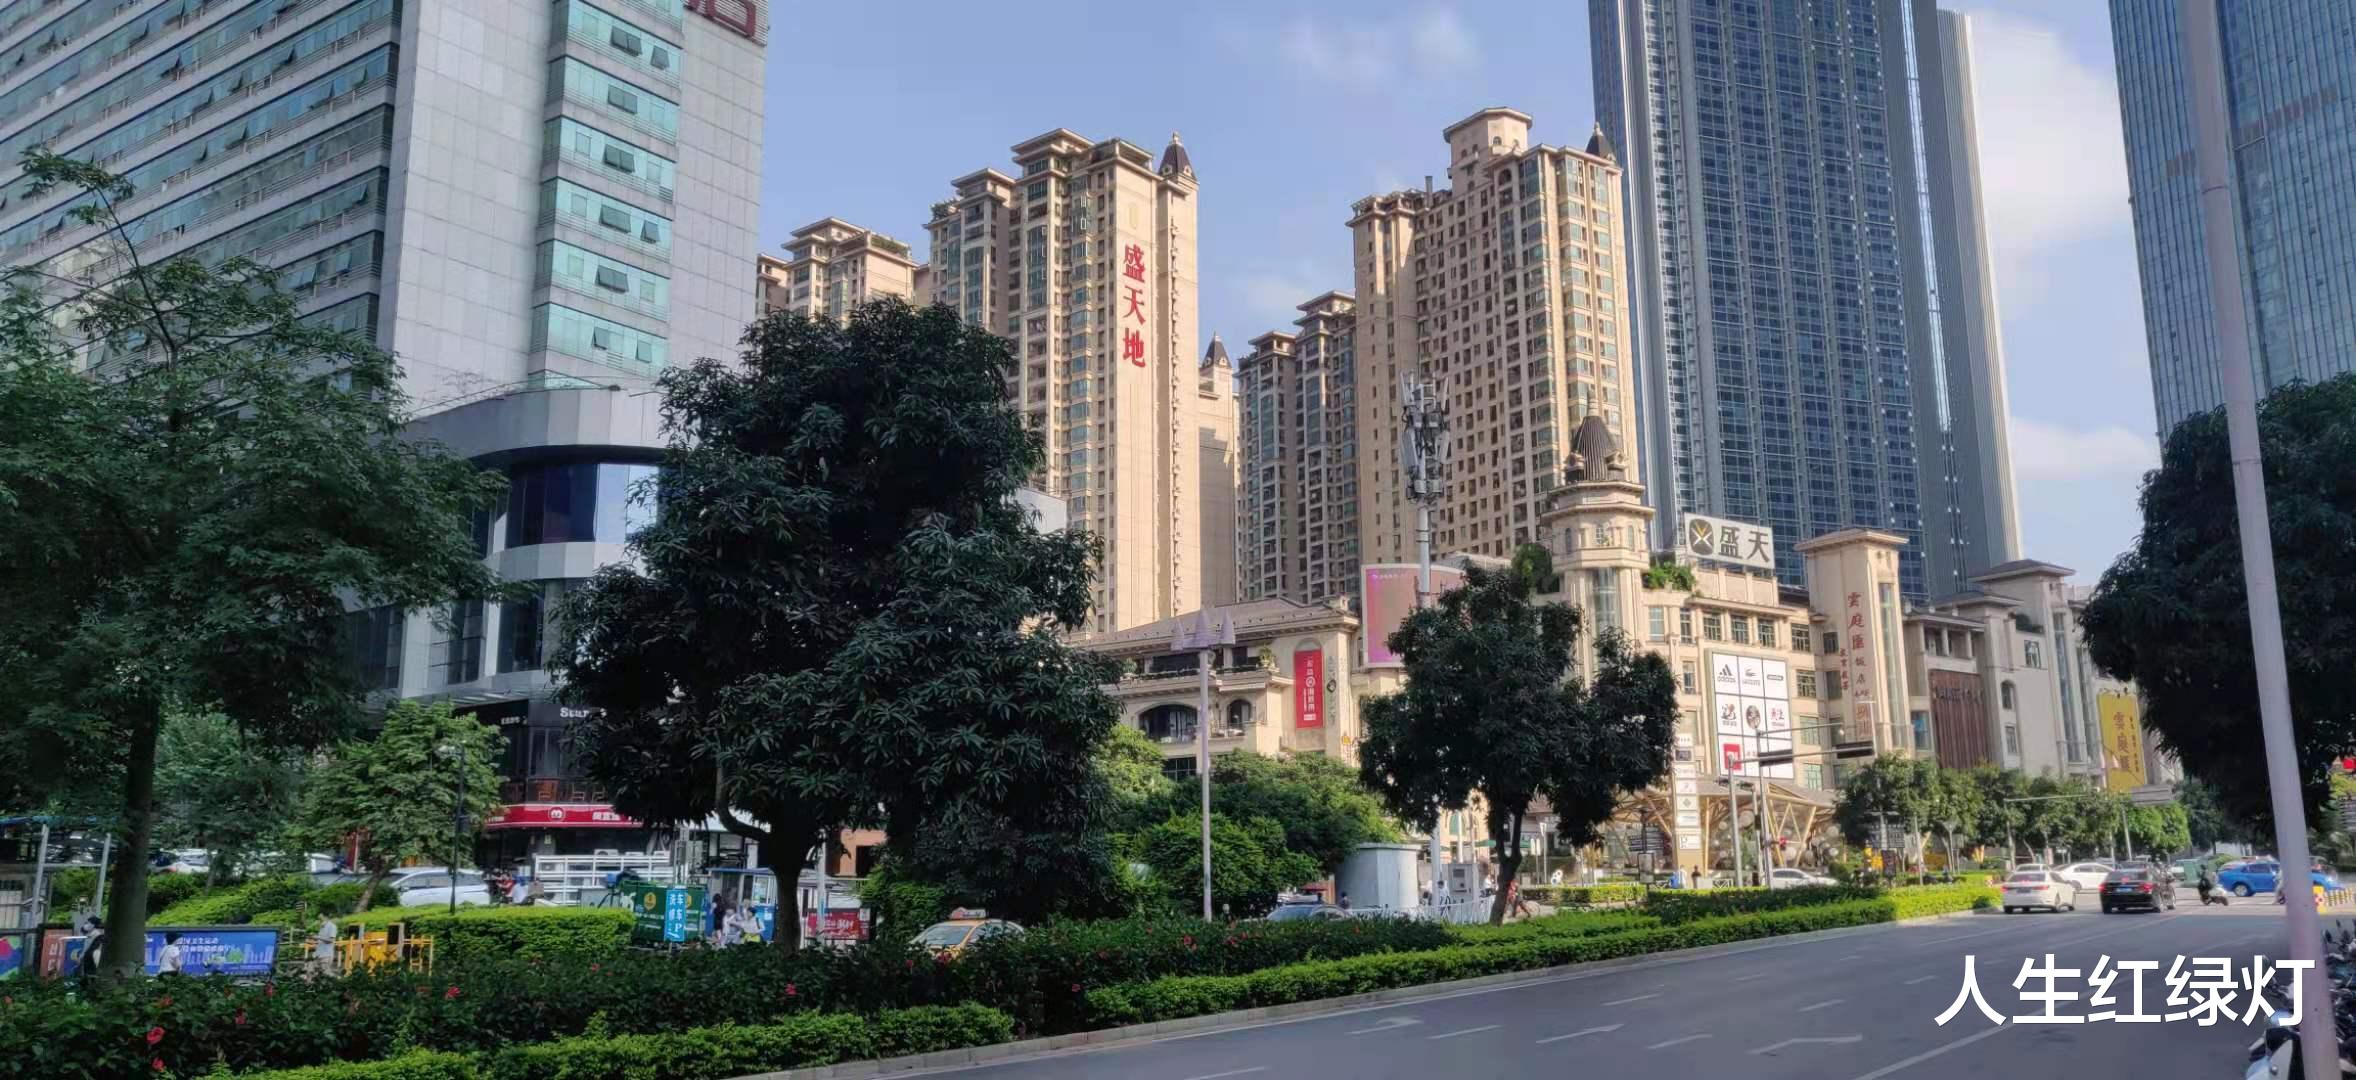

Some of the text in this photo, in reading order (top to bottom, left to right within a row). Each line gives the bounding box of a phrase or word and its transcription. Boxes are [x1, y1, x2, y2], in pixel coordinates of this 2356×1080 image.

[1122, 243, 1147, 369] 盛天地
[1718, 525, 1772, 563] 盛天
